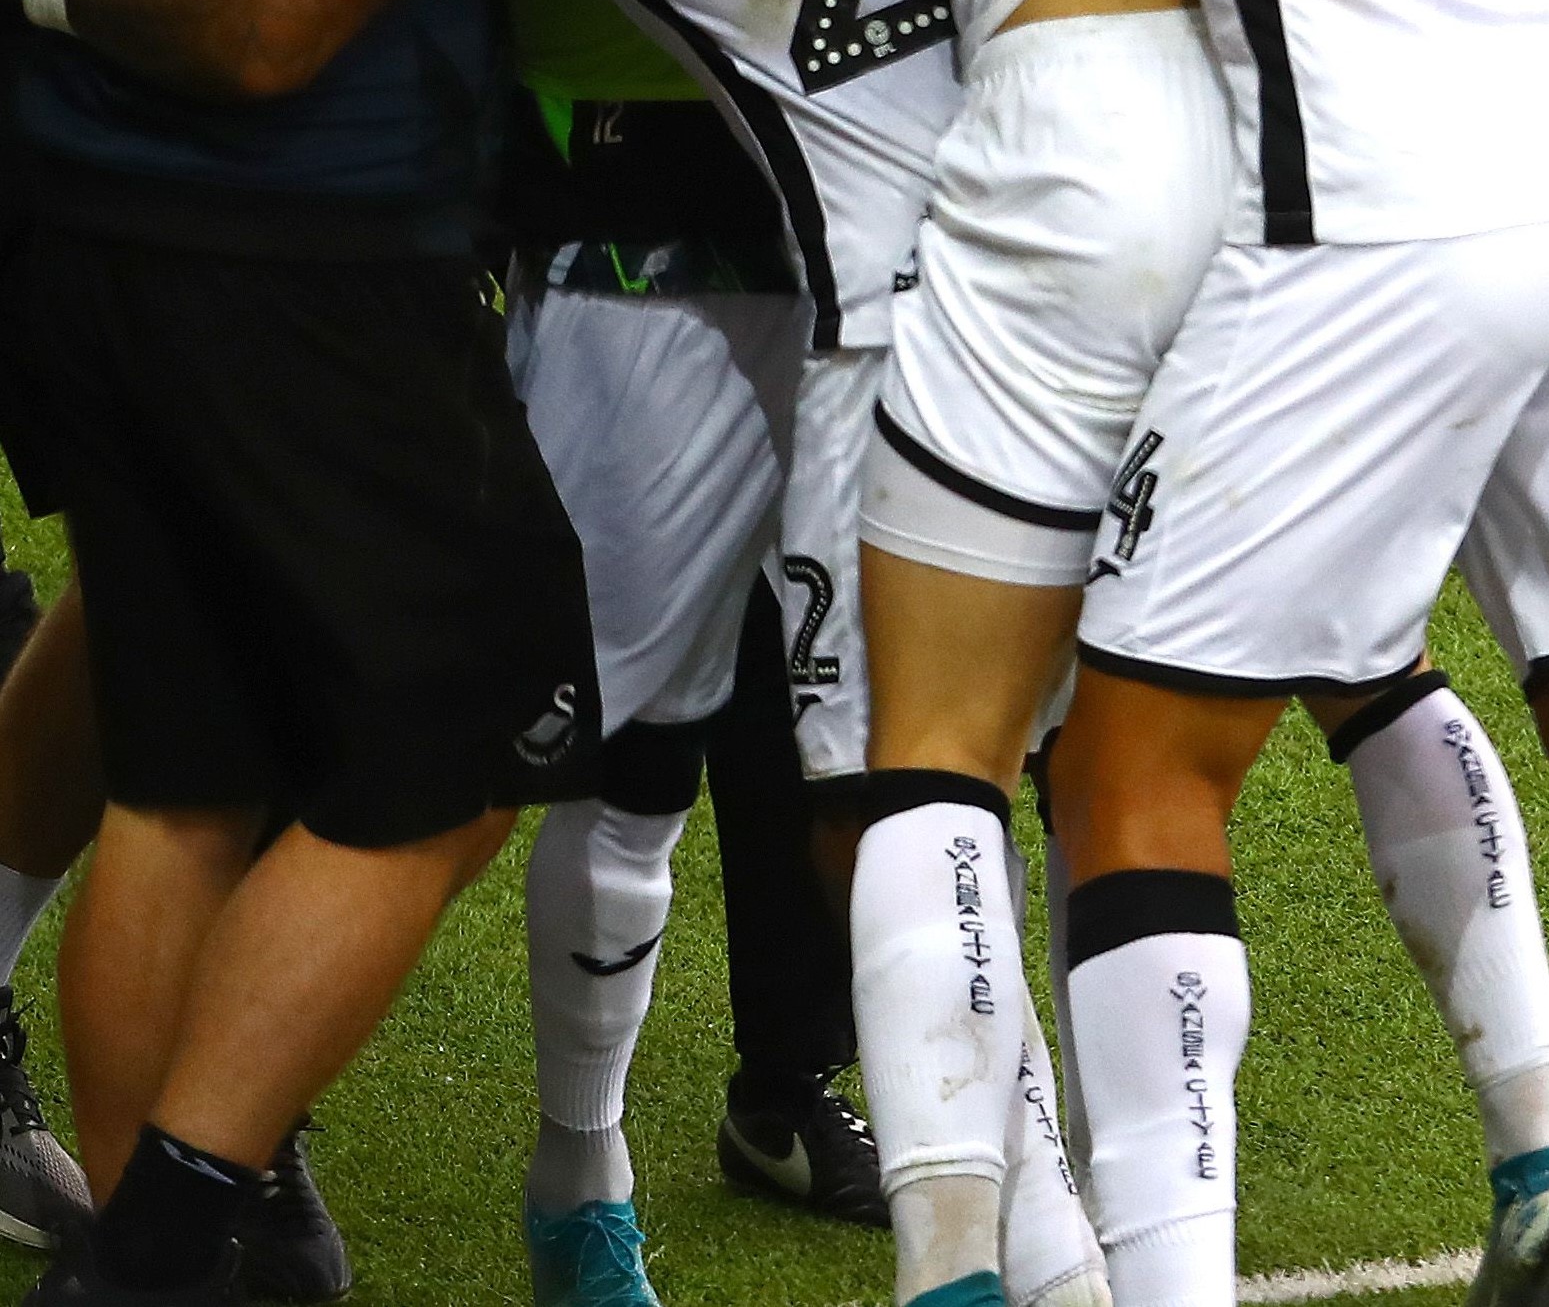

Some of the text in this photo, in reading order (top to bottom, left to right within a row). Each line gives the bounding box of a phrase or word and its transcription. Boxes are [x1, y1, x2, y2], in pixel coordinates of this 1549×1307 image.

[783, 555, 840, 685] 2
[960, 921, 992, 969] CITY
[1185, 1078, 1213, 1135] CITY
